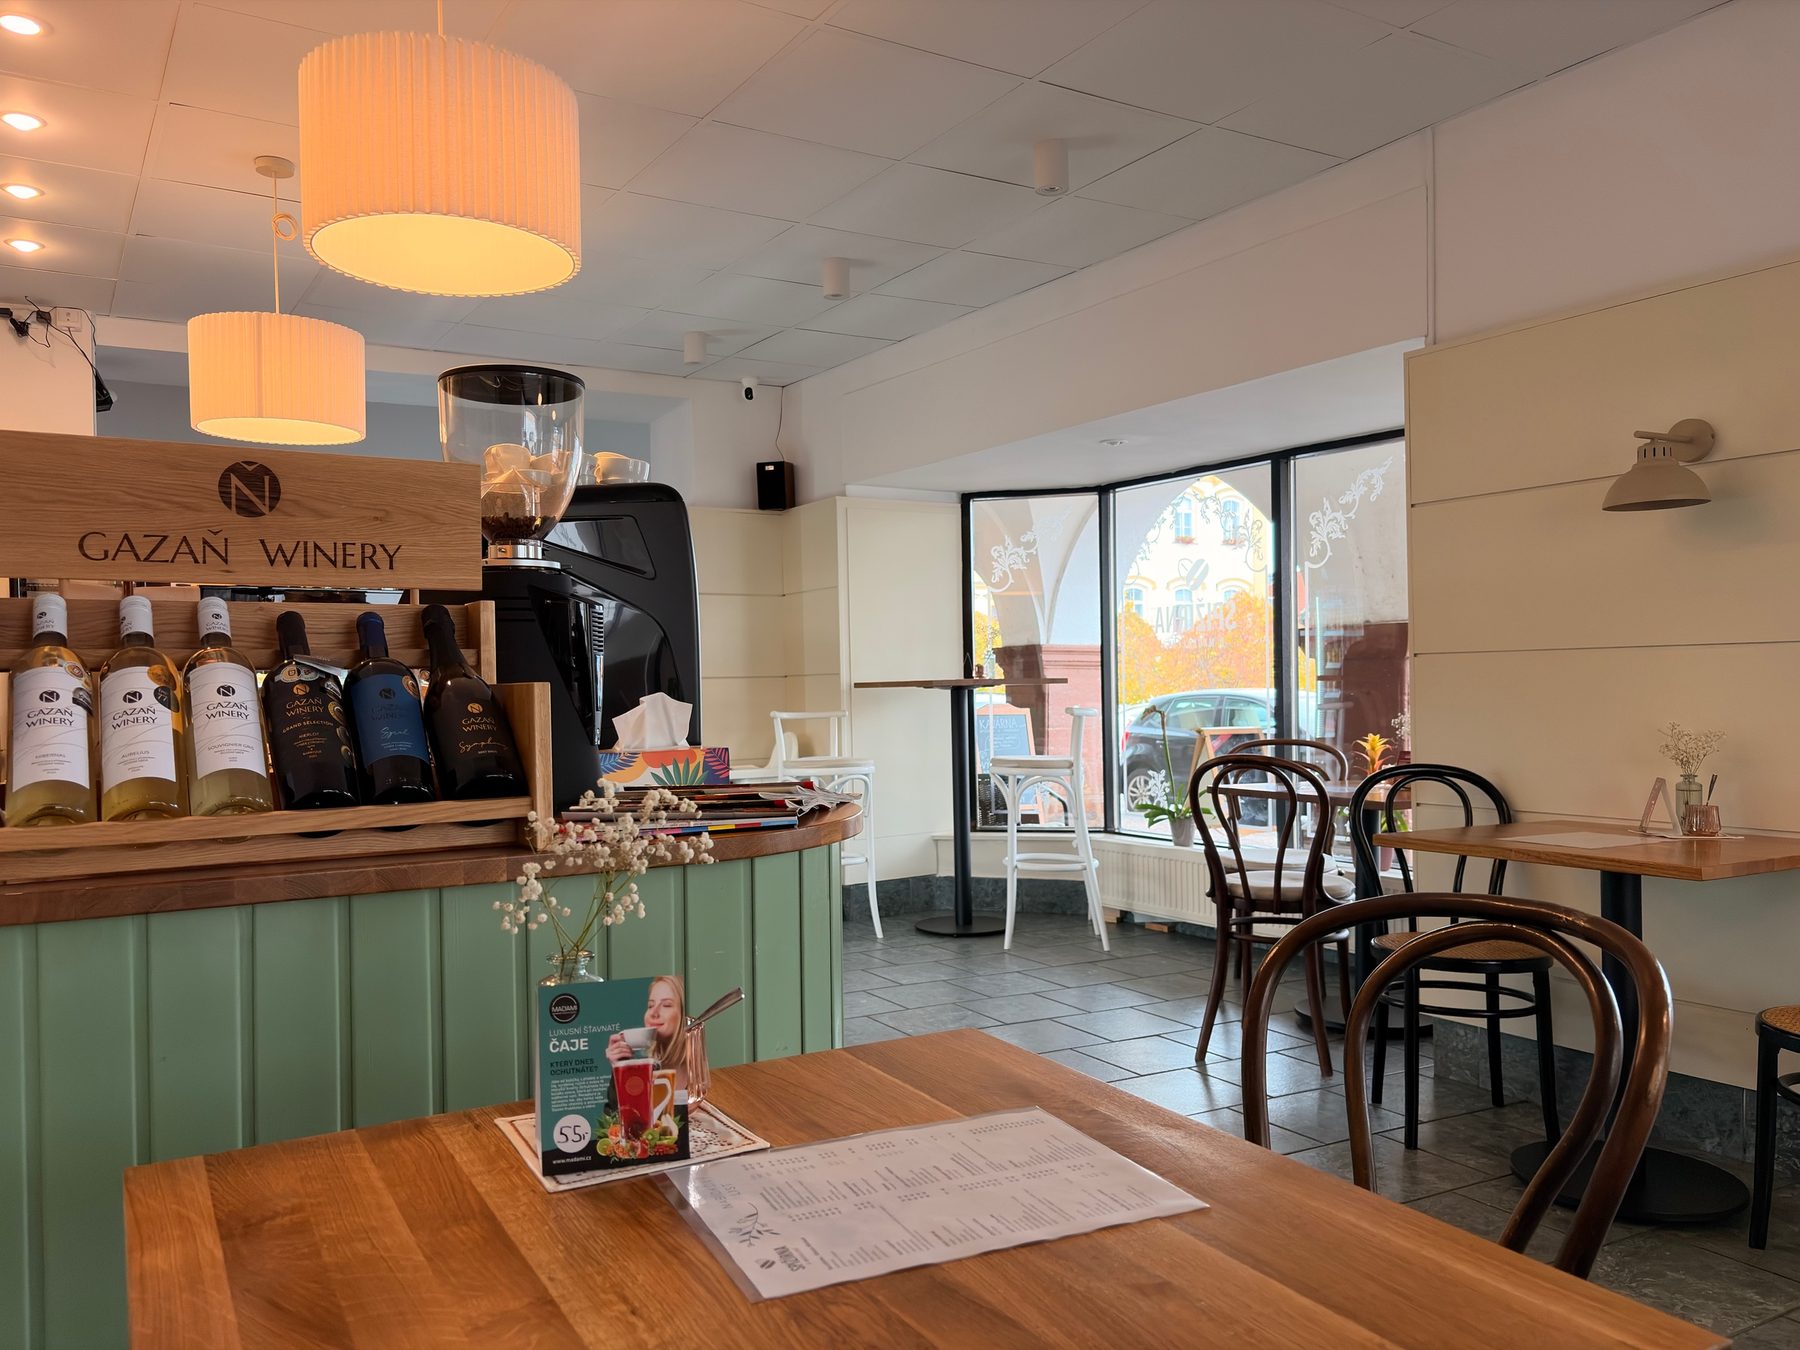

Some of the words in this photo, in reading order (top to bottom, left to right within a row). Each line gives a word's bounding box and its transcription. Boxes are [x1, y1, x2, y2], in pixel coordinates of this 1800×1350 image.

[78, 529, 229, 565] GAZAŇ
[259, 538, 402, 571] WINERY
[205, 710, 250, 720] WINERY
[286, 705, 325, 717] WINERY
[25, 717, 75, 728] WINERY
[111, 716, 158, 730] WINERY
[549, 1038, 589, 1053] ČAJE
